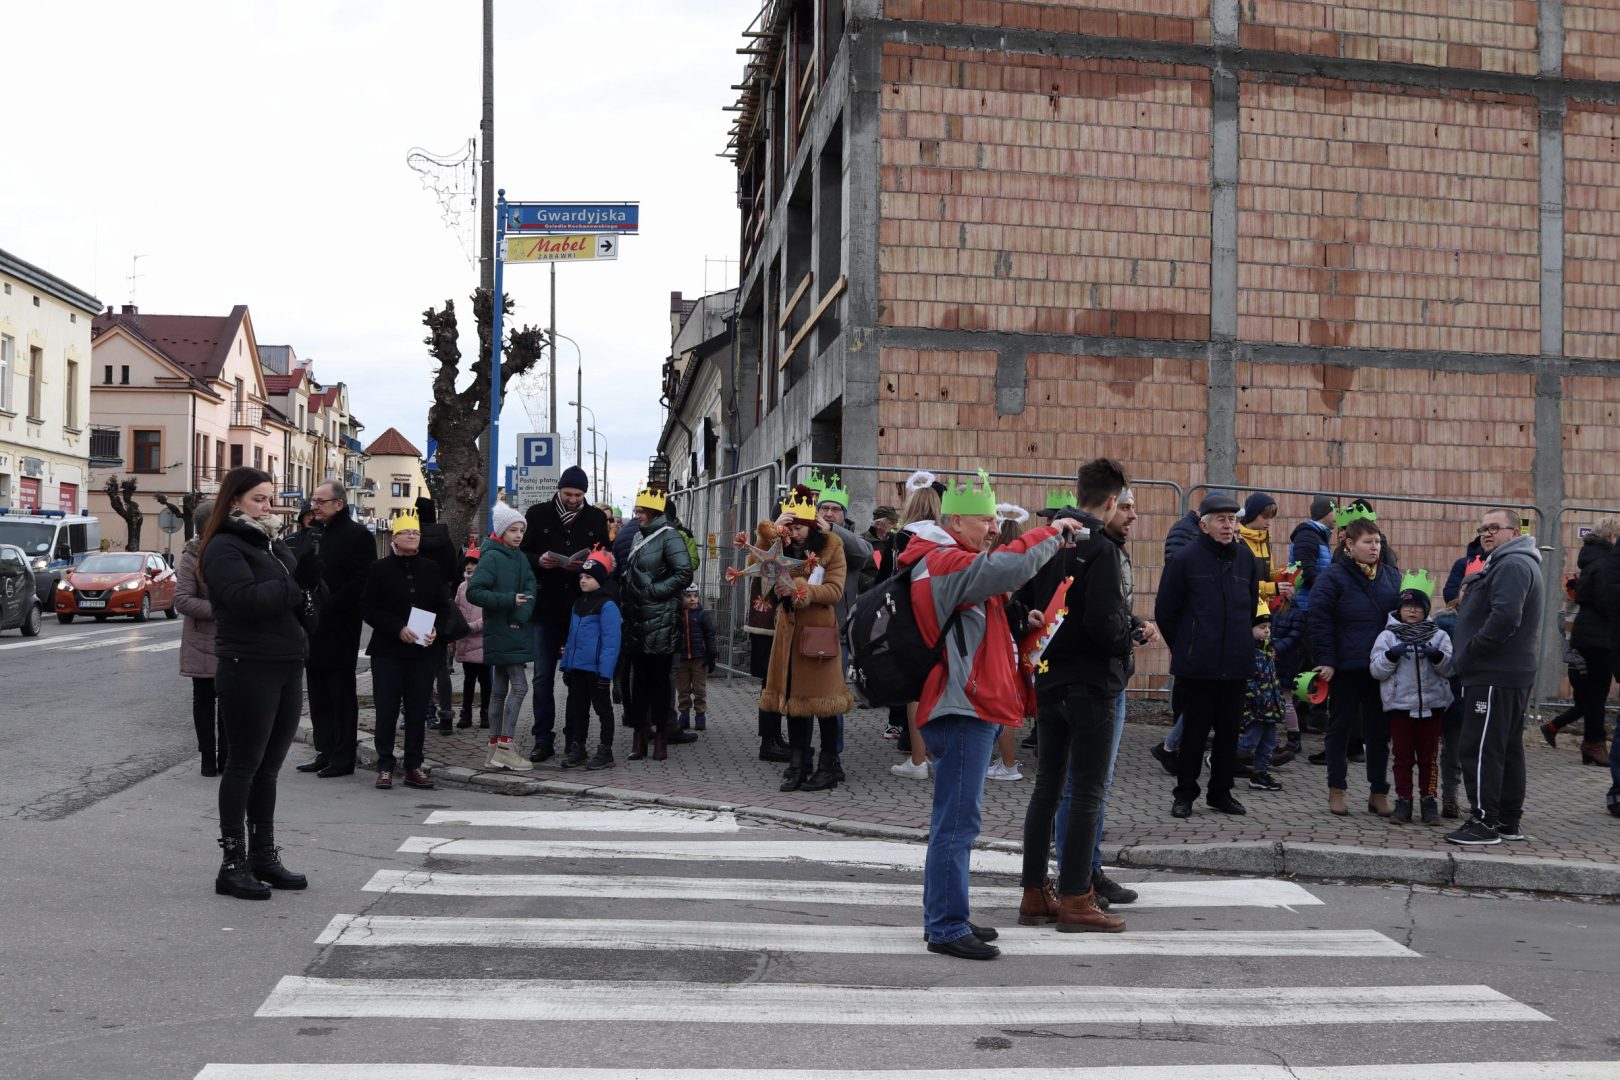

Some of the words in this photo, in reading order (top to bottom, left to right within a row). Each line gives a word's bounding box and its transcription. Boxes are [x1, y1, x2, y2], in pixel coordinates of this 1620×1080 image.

[537, 209, 626, 224] Gwardyjska
[527, 236, 586, 257] Mabel
[530, 441, 547, 463] P
[1474, 703, 1487, 713] 32
